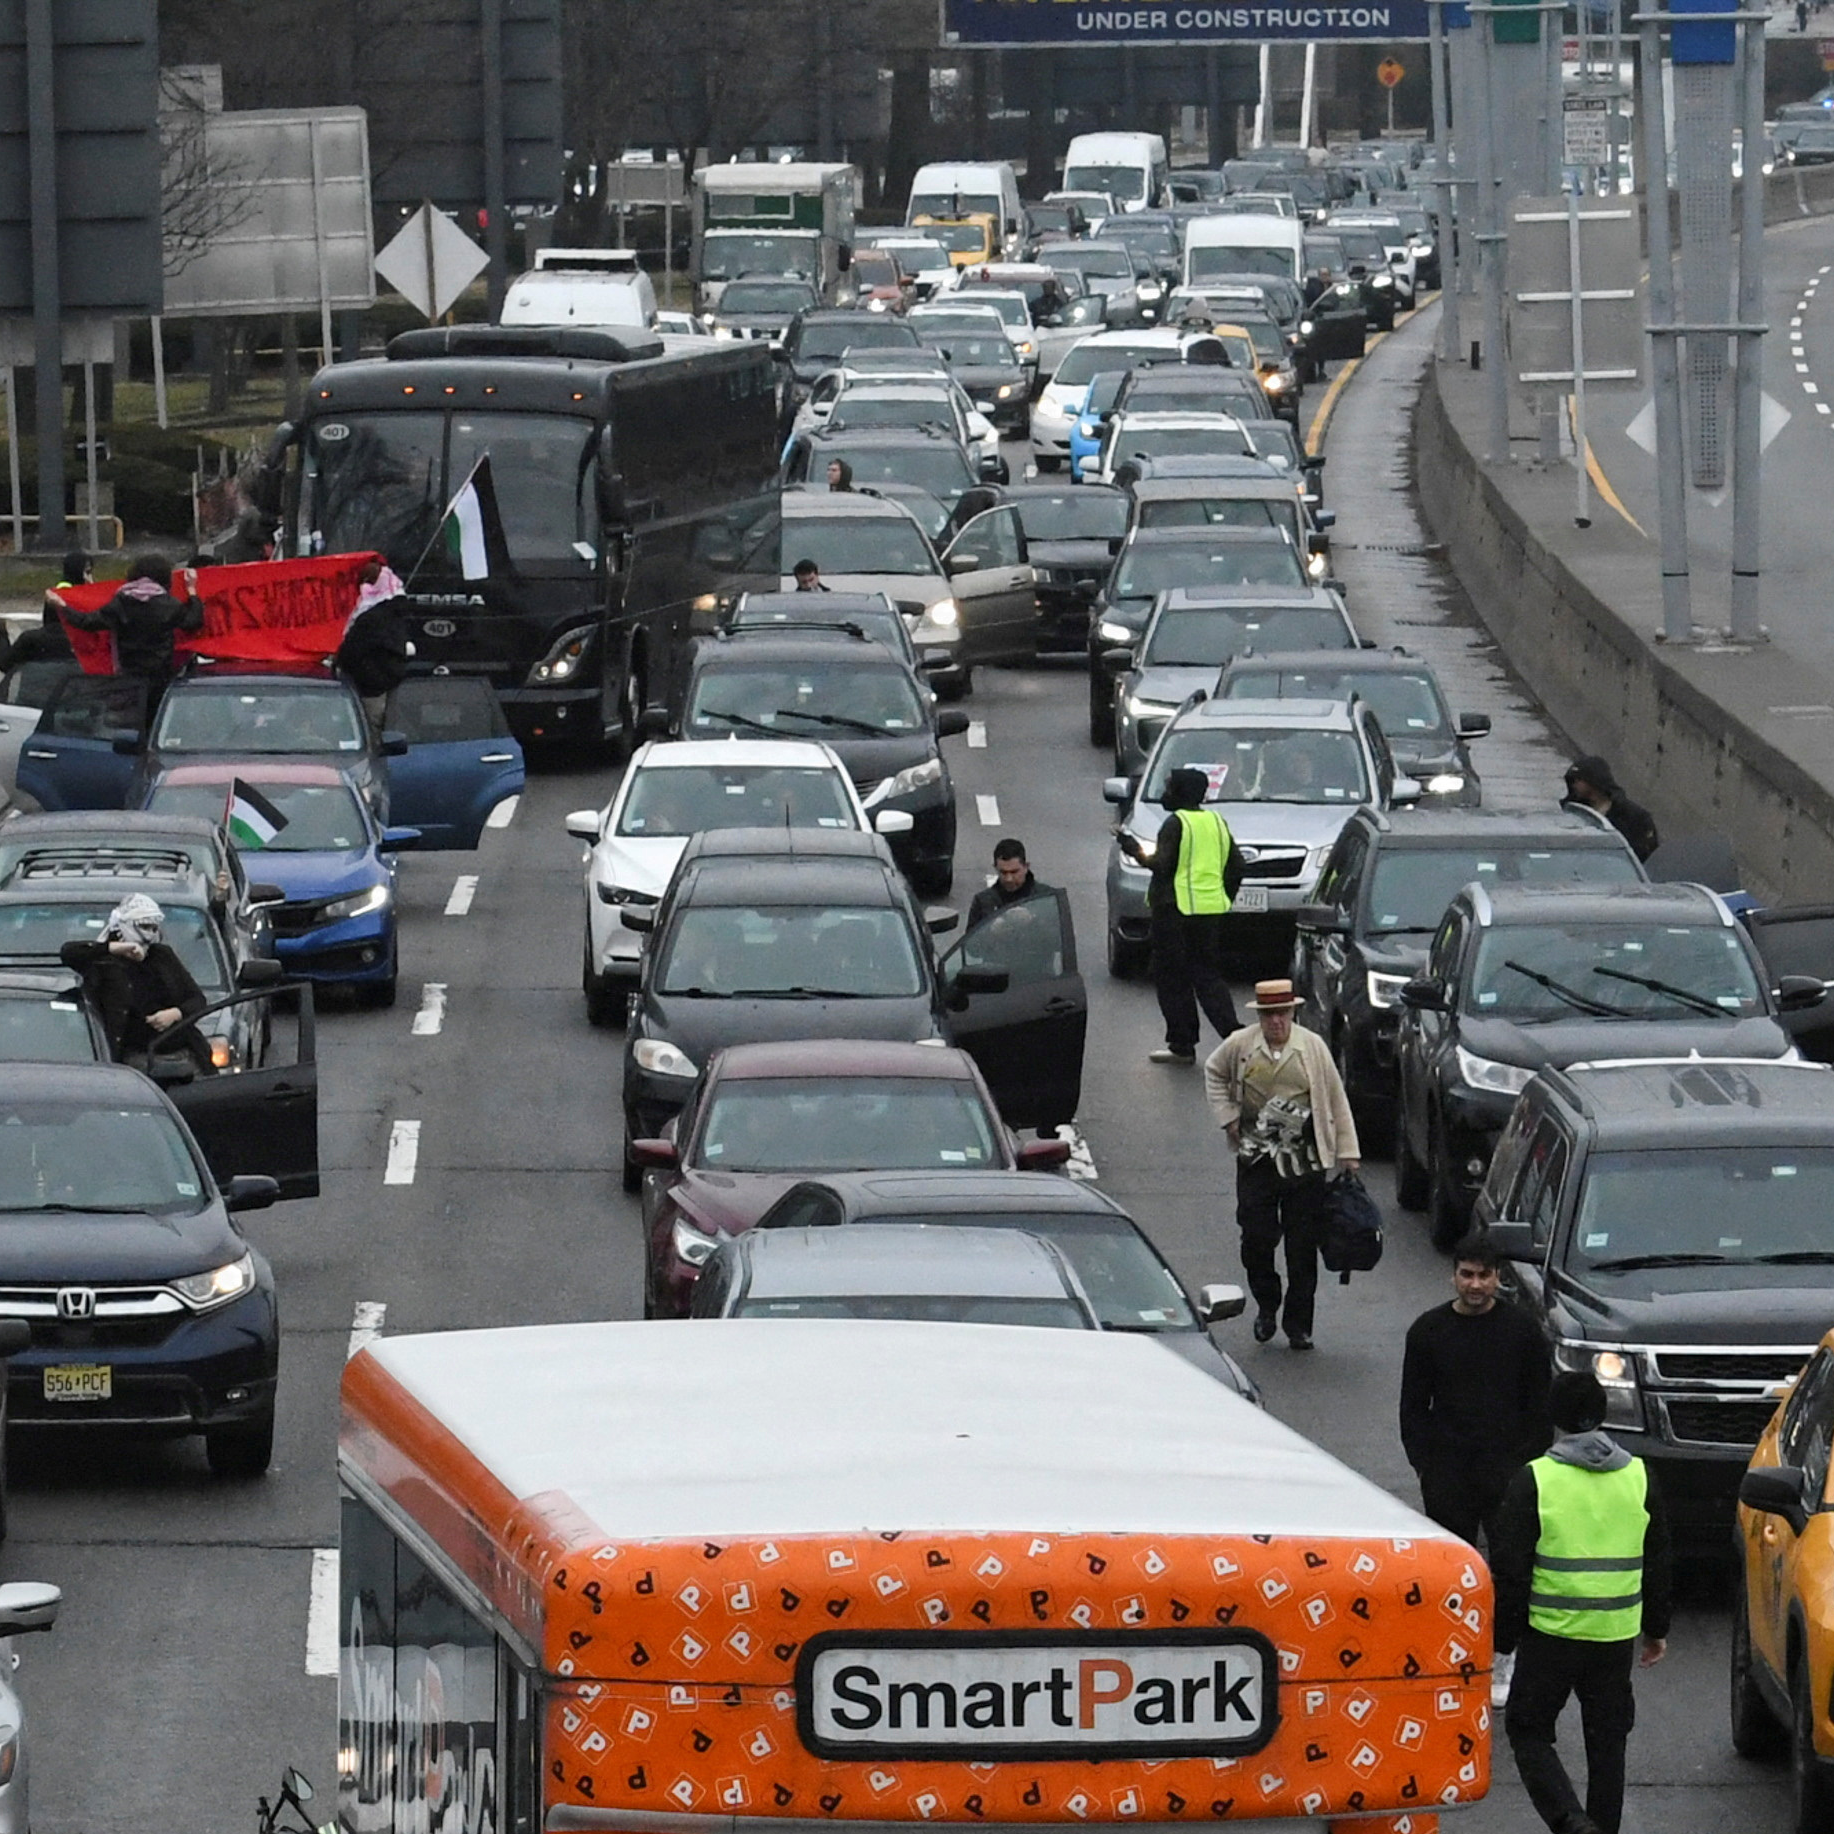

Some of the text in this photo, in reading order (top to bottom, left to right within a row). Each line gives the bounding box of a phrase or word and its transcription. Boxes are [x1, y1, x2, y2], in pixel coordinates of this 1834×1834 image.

[1077, 9, 1390, 30] UNDER CONSTRUCTION
[428, 622, 452, 634] 401
[82, 1372, 108, 1391] PCF
[831, 1659, 1255, 1730] SmartPark
